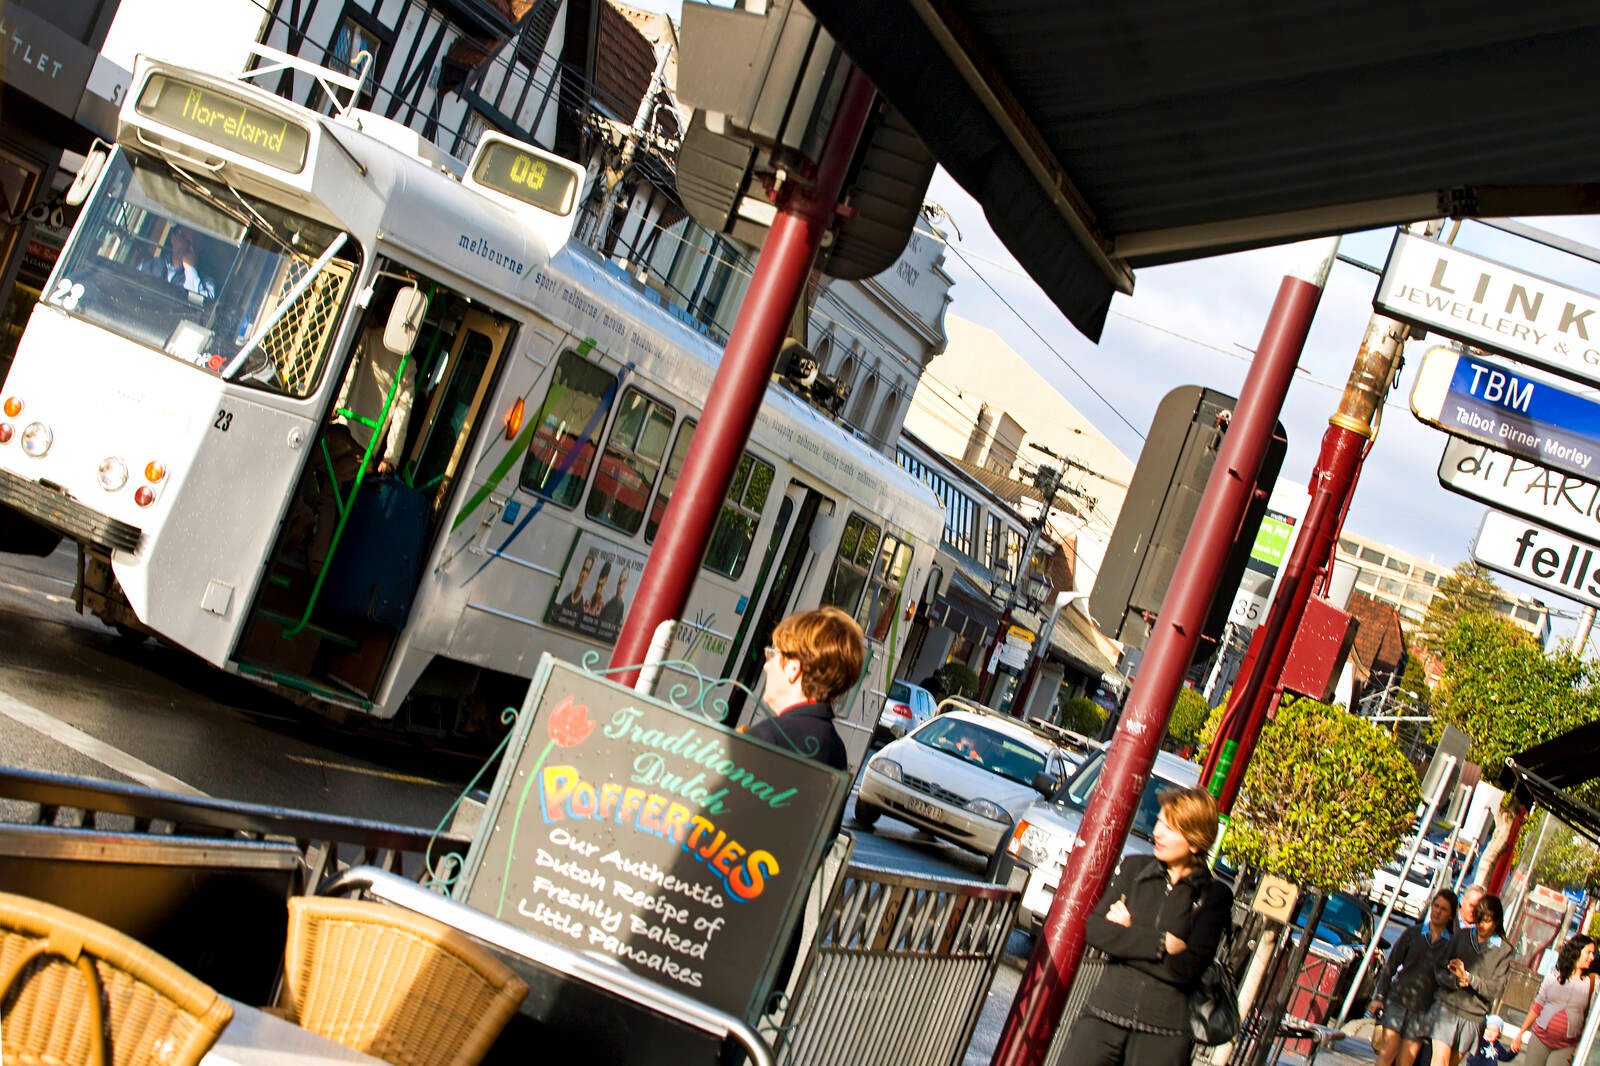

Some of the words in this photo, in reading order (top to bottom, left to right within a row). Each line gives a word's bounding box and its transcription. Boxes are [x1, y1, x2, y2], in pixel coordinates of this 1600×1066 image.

[183, 88, 288, 153] Moreland
[510, 154, 548, 191] 08
[49, 278, 85, 310] 23
[458, 233, 523, 276] melbourne
[534, 272, 557, 295] sport
[561, 287, 598, 319] melbourne
[602, 313, 626, 336] movies
[1394, 284, 1547, 345] JEWELLERY
[1553, 341, 1570, 356] &
[213, 409, 234, 432] 23
[1469, 363, 1535, 413] TBM
[1456, 406, 1496, 434] Talbot
[1498, 423, 1542, 449] Birner
[1543, 438, 1593, 469] Morley
[1235, 599, 1260, 620] 35
[603, 706, 799, 809] Traditional
[631, 753, 733, 815] Dutch
[537, 764, 781, 904] POFFERTJES
[535, 849, 607, 893] Dutch
[612, 878, 689, 928] Recipe
[693, 911, 726, 944] of
[549, 828, 601, 862] Our
[600, 849, 725, 910] Authentic
[1264, 884, 1290, 909] S
[517, 898, 582, 939] Little
[588, 925, 703, 989] Pancakes
[532, 875, 622, 933] Freshly
[629, 915, 708, 962] Baked
